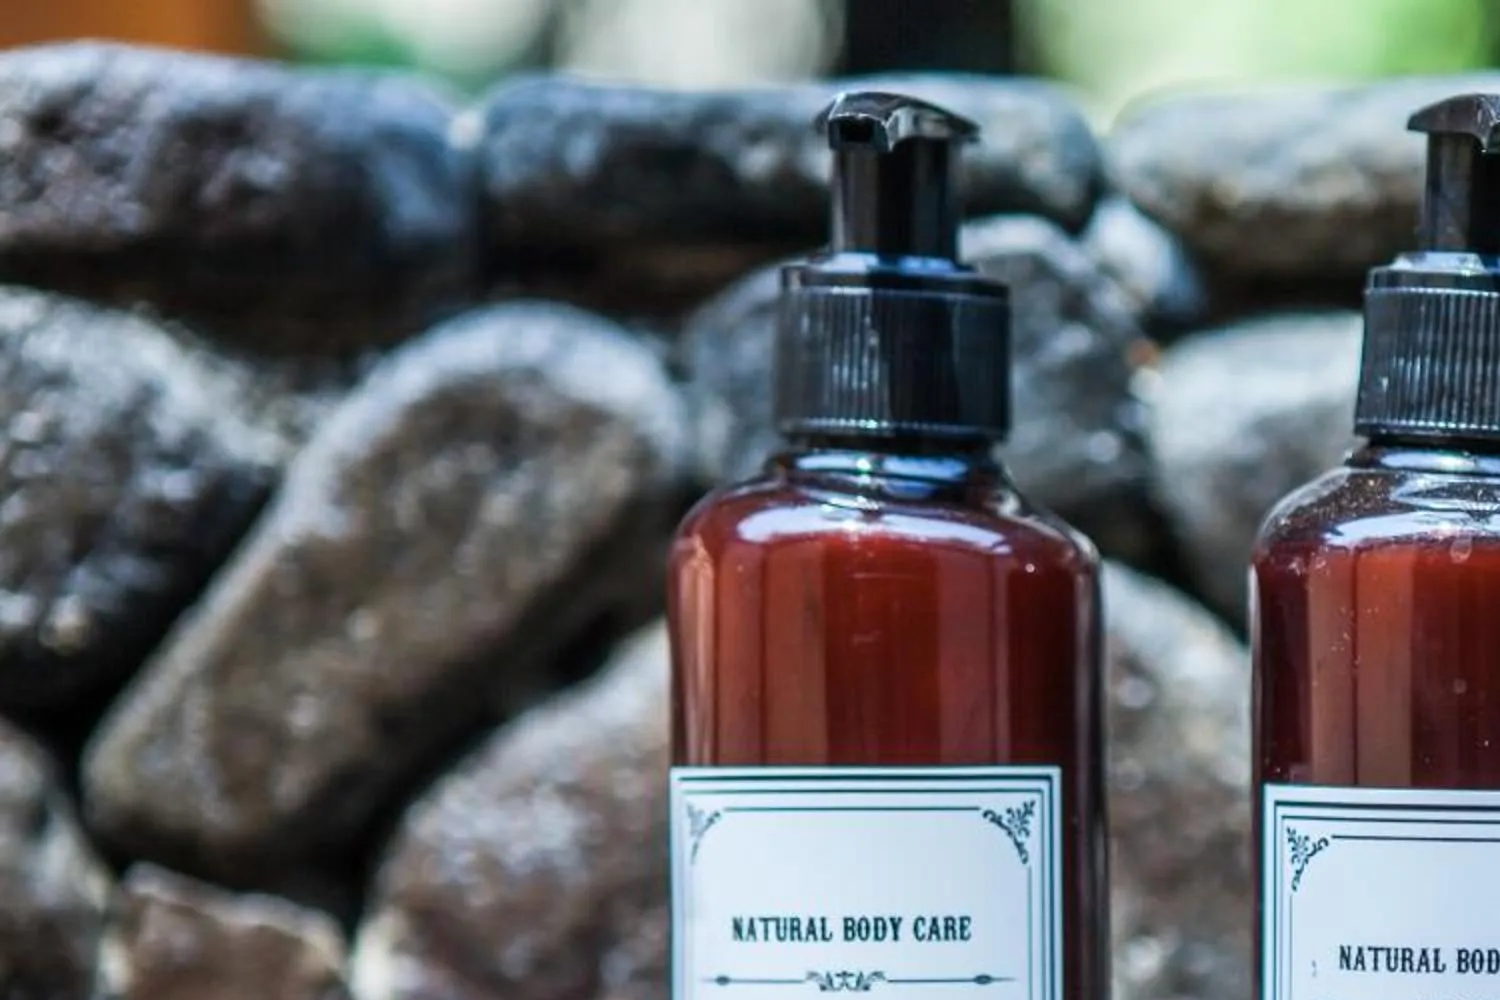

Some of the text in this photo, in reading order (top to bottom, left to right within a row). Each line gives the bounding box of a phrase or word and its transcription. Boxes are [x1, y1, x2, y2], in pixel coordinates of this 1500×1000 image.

[732, 916, 972, 943] NATURAL BODY CARE
[1339, 945, 1446, 974] NATURAL
